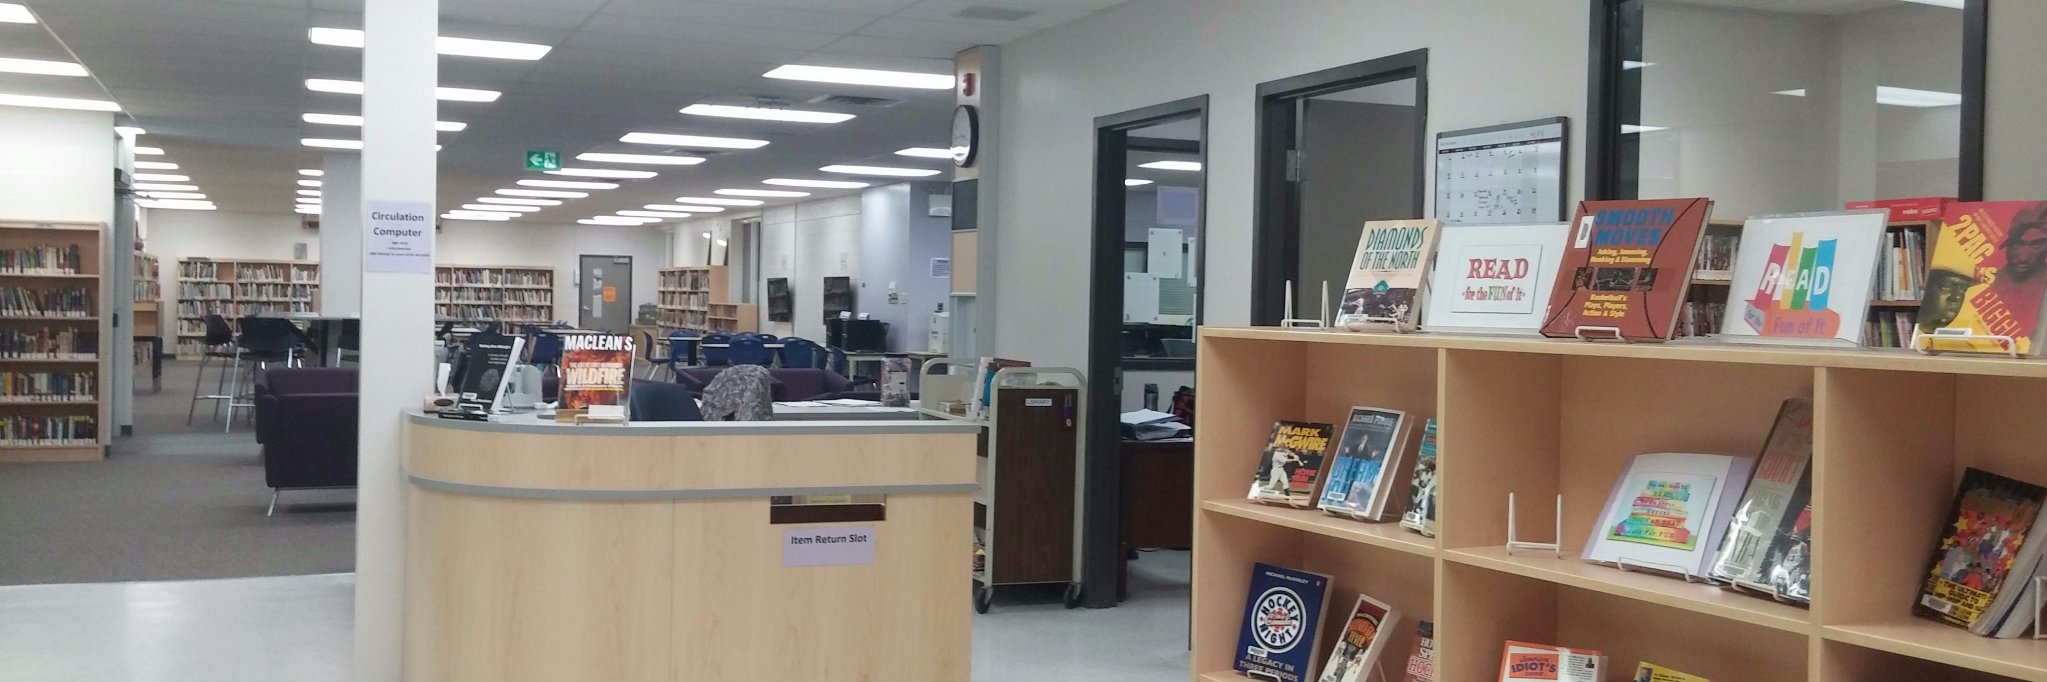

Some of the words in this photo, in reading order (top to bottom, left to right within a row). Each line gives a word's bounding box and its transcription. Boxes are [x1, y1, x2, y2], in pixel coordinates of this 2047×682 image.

[371, 211, 425, 222] Circulation
[1594, 208, 1675, 226] SMOOTH
[373, 227, 422, 238] Computer
[1365, 226, 1428, 250] DIAMONDS
[1594, 228, 1662, 246] MOVES
[1949, 214, 1995, 265] 2PAC
[1360, 251, 1373, 270] OF
[1372, 251, 1390, 270] THE
[1389, 250, 1420, 270] NORTH
[1466, 258, 1529, 280] READ
[1759, 262, 1830, 296] READ
[1476, 286, 1487, 300] the
[1488, 285, 1508, 301] FUN
[1507, 286, 1516, 300] of
[1774, 316, 1796, 334] Fun
[1797, 316, 1812, 335] of
[564, 334, 634, 351] MACLEAN'S
[566, 367, 626, 385] WILDFIRE
[1278, 425, 1321, 437] MARK
[791, 536, 813, 545] Item
[815, 534, 847, 544] Return
[849, 533, 867, 543] Slot
[1261, 596, 1299, 622] HOCKEY
[1260, 623, 1293, 644] NIGHT
[1239, 660, 1264, 672] THREE
[1265, 667, 1299, 682] PERIODS
[1253, 655, 1284, 669] LEGACY
[1284, 663, 1295, 672] IN
[1511, 662, 1557, 673] IDIOT'S
